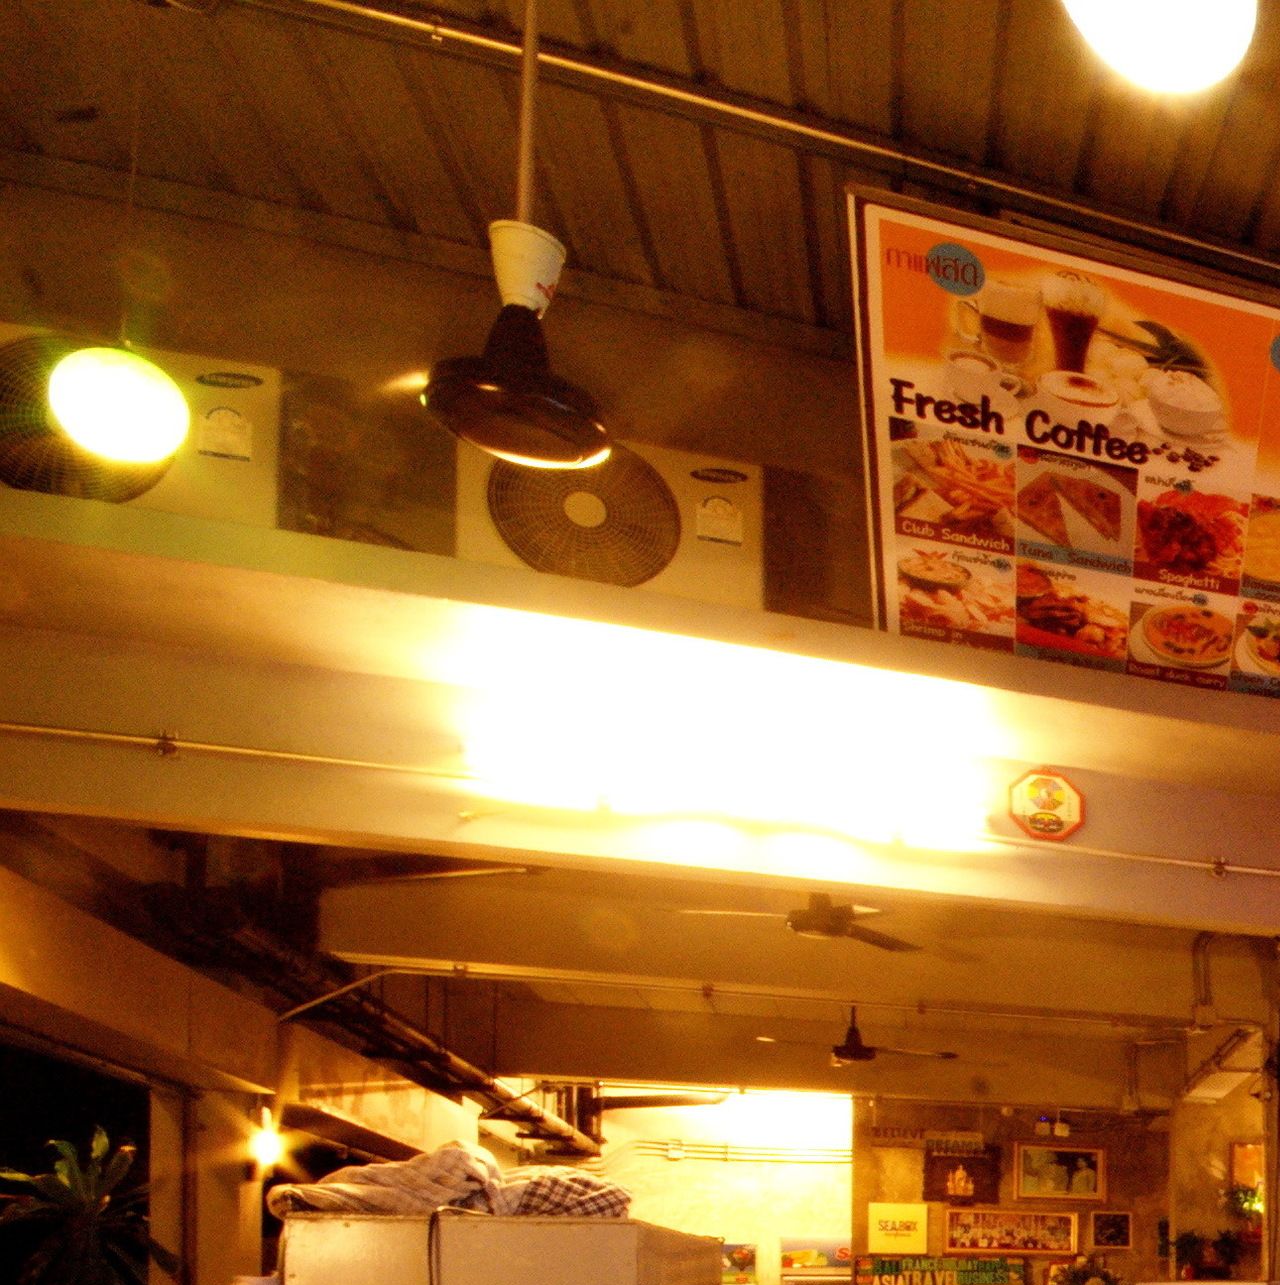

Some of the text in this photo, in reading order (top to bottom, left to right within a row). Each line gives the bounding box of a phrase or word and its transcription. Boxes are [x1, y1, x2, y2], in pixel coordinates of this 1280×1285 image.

[884, 247, 980, 288] กาแฟสด
[889, 377, 1005, 436] Fresh
[1025, 408, 1149, 465] Coffee
[902, 520, 1011, 552] Club Sandwich
[1159, 568, 1221, 591] Spaghetti
